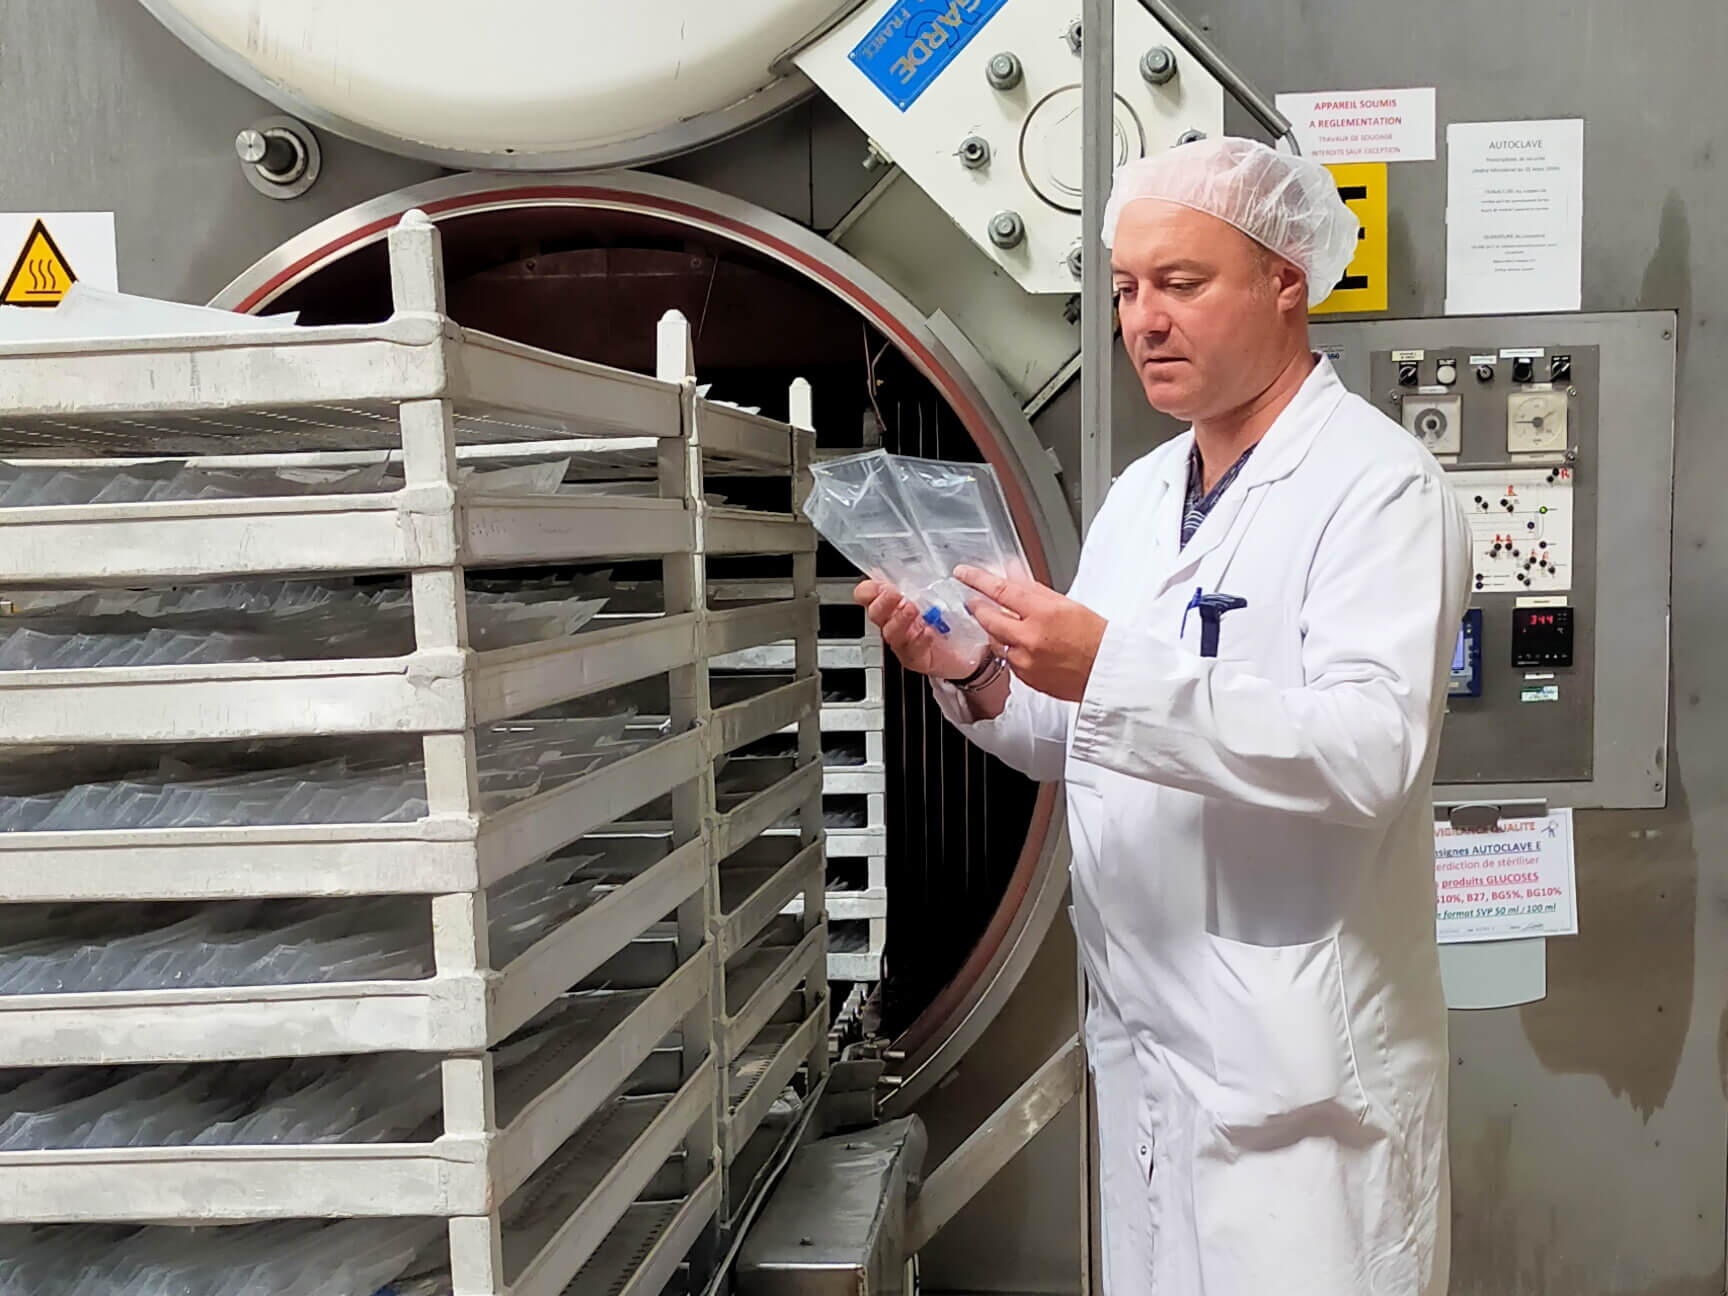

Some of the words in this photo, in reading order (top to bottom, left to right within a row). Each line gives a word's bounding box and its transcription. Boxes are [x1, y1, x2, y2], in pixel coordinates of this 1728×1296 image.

[1314, 101, 1357, 110] APPAREIL
[1359, 99, 1397, 108] SOUMIS
[1309, 120, 1316, 128] A
[1318, 117, 1402, 128] REGLEMENTATION
[1489, 140, 1543, 149] AUTOCLAVE
[1472, 842, 1534, 854] AUTOCLAVE
[1482, 859, 1495, 868] de
[1442, 877, 1483, 889] produits
[1486, 872, 1539, 884] GLUCOSES
[1466, 893, 1488, 902] B27,
[1491, 890, 1524, 900] BG5%,
[1527, 887, 1562, 898] BG10%
[1443, 909, 1474, 920] format
[1476, 908, 1493, 918] SVP
[1527, 904, 1543, 913] 100
[1544, 902, 1557, 912] ml
